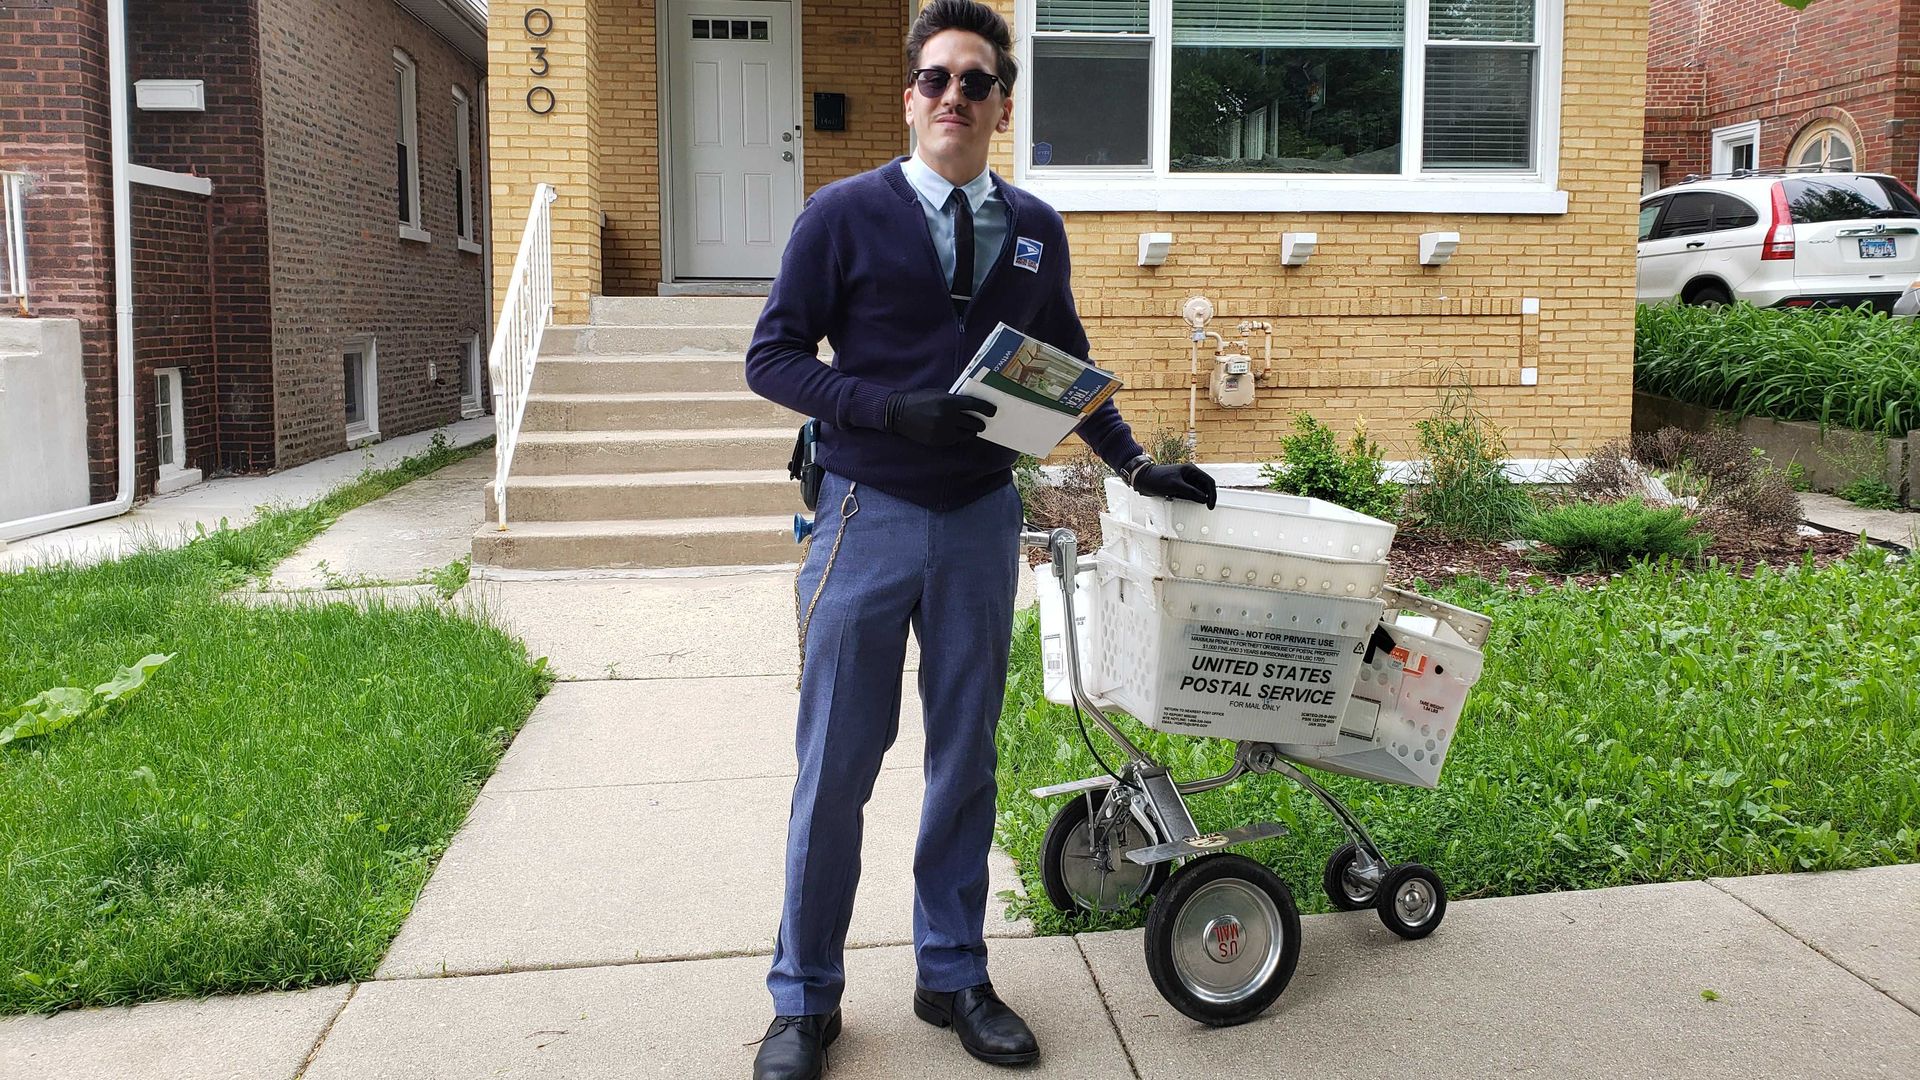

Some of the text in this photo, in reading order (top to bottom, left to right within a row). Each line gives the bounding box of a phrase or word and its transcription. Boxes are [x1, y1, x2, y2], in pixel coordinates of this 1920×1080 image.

[1191, 635, 1214, 643] MAXIMUM
[1214, 638, 1238, 646] PENALTY
[1247, 641, 1262, 649] THEFT
[1270, 644, 1288, 652] MISUSE
[1296, 647, 1313, 655] POSTAL
[1313, 649, 1340, 657] PROPERTY
[1200, 624, 1239, 636] WARNING
[1245, 630, 1263, 640] NOT
[1264, 632, 1281, 642] FOR
[1283, 634, 1316, 646] PRIVATE
[1318, 638, 1335, 648] USE
[1217, 644, 1228, 652] FINE
[1243, 648, 1259, 656] YEARS
[1259, 650, 1295, 659] IMPRISONMENT
[1191, 655, 1332, 684] UNITED STATES
[1180, 675, 1336, 706] POSTAL SERVICE
[1229, 700, 1281, 712] FOR MAIL ONLY
[1212, 922, 1239, 943] MAIL
[1218, 940, 1238, 958] US
